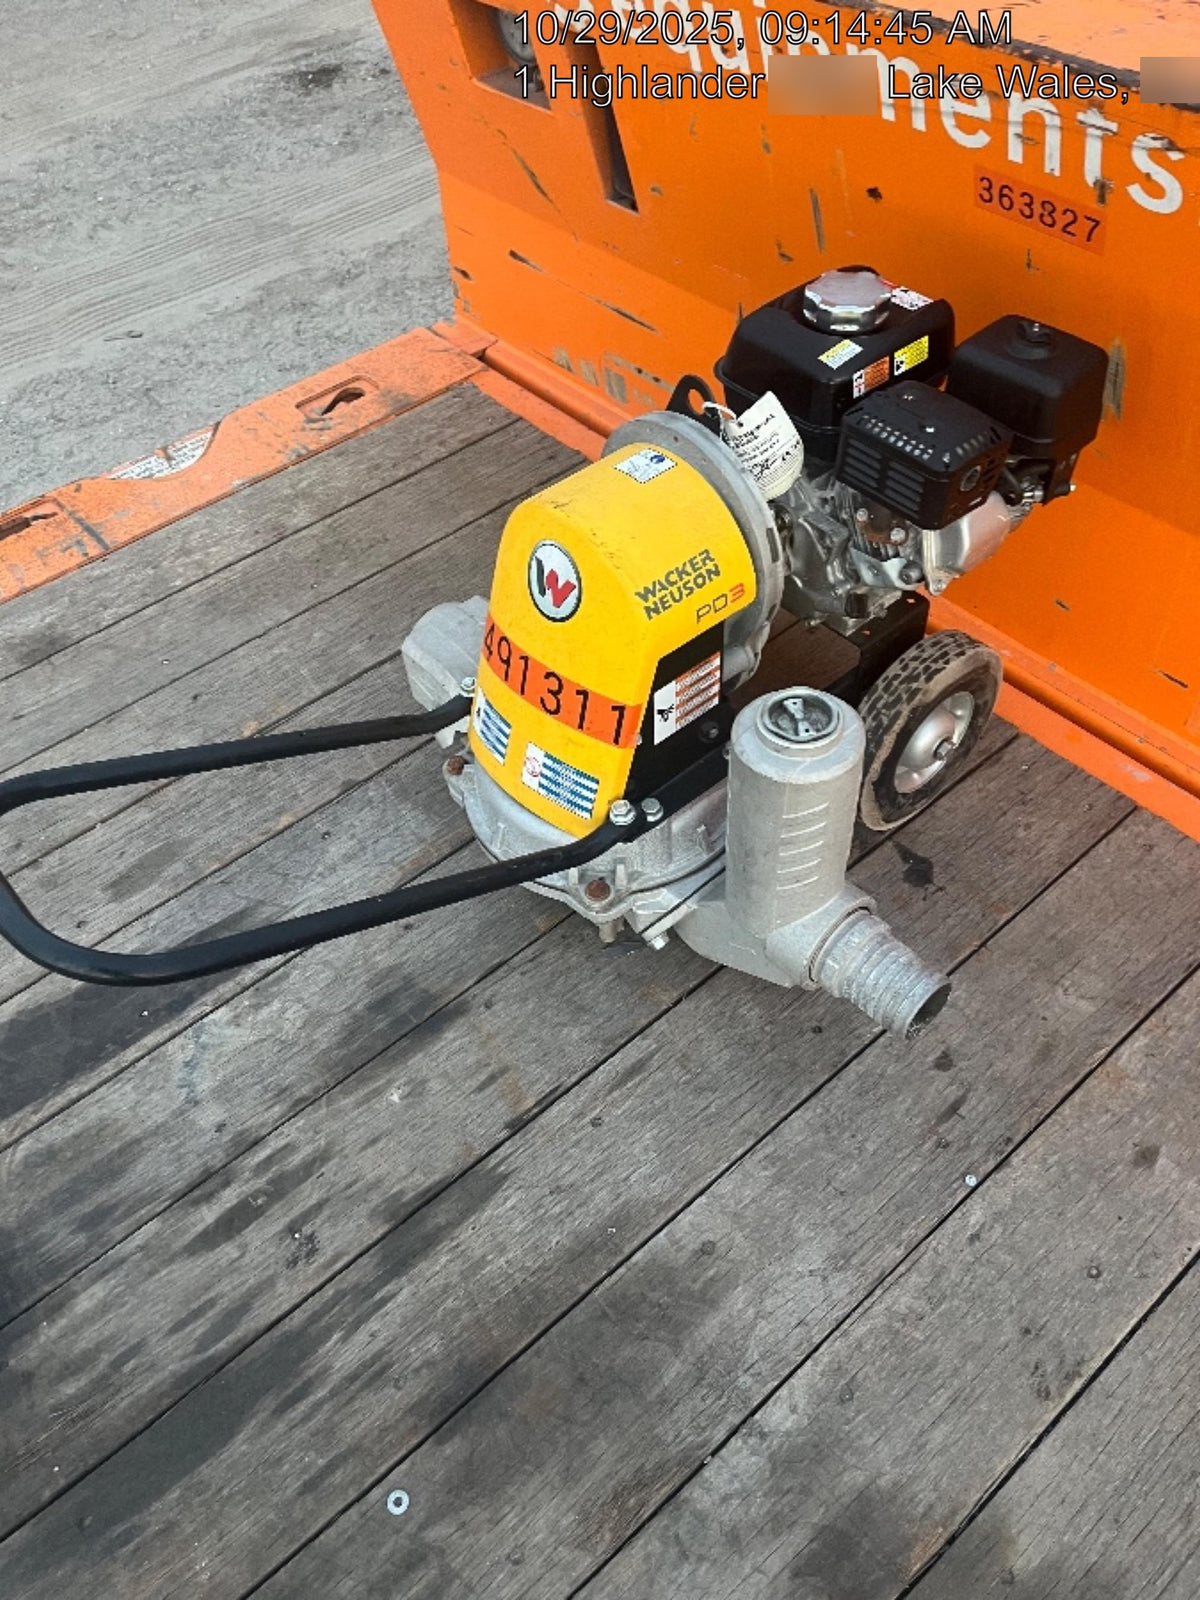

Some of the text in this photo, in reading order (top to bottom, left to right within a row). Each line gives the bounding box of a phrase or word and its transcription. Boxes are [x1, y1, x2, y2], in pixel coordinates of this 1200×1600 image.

[978, 176, 1101, 242] 363827
[635, 549, 715, 603] WACKER
[643, 563, 721, 620] NEUSON
[696, 582, 746, 624] PD3
[484, 622, 626, 746] 491311
